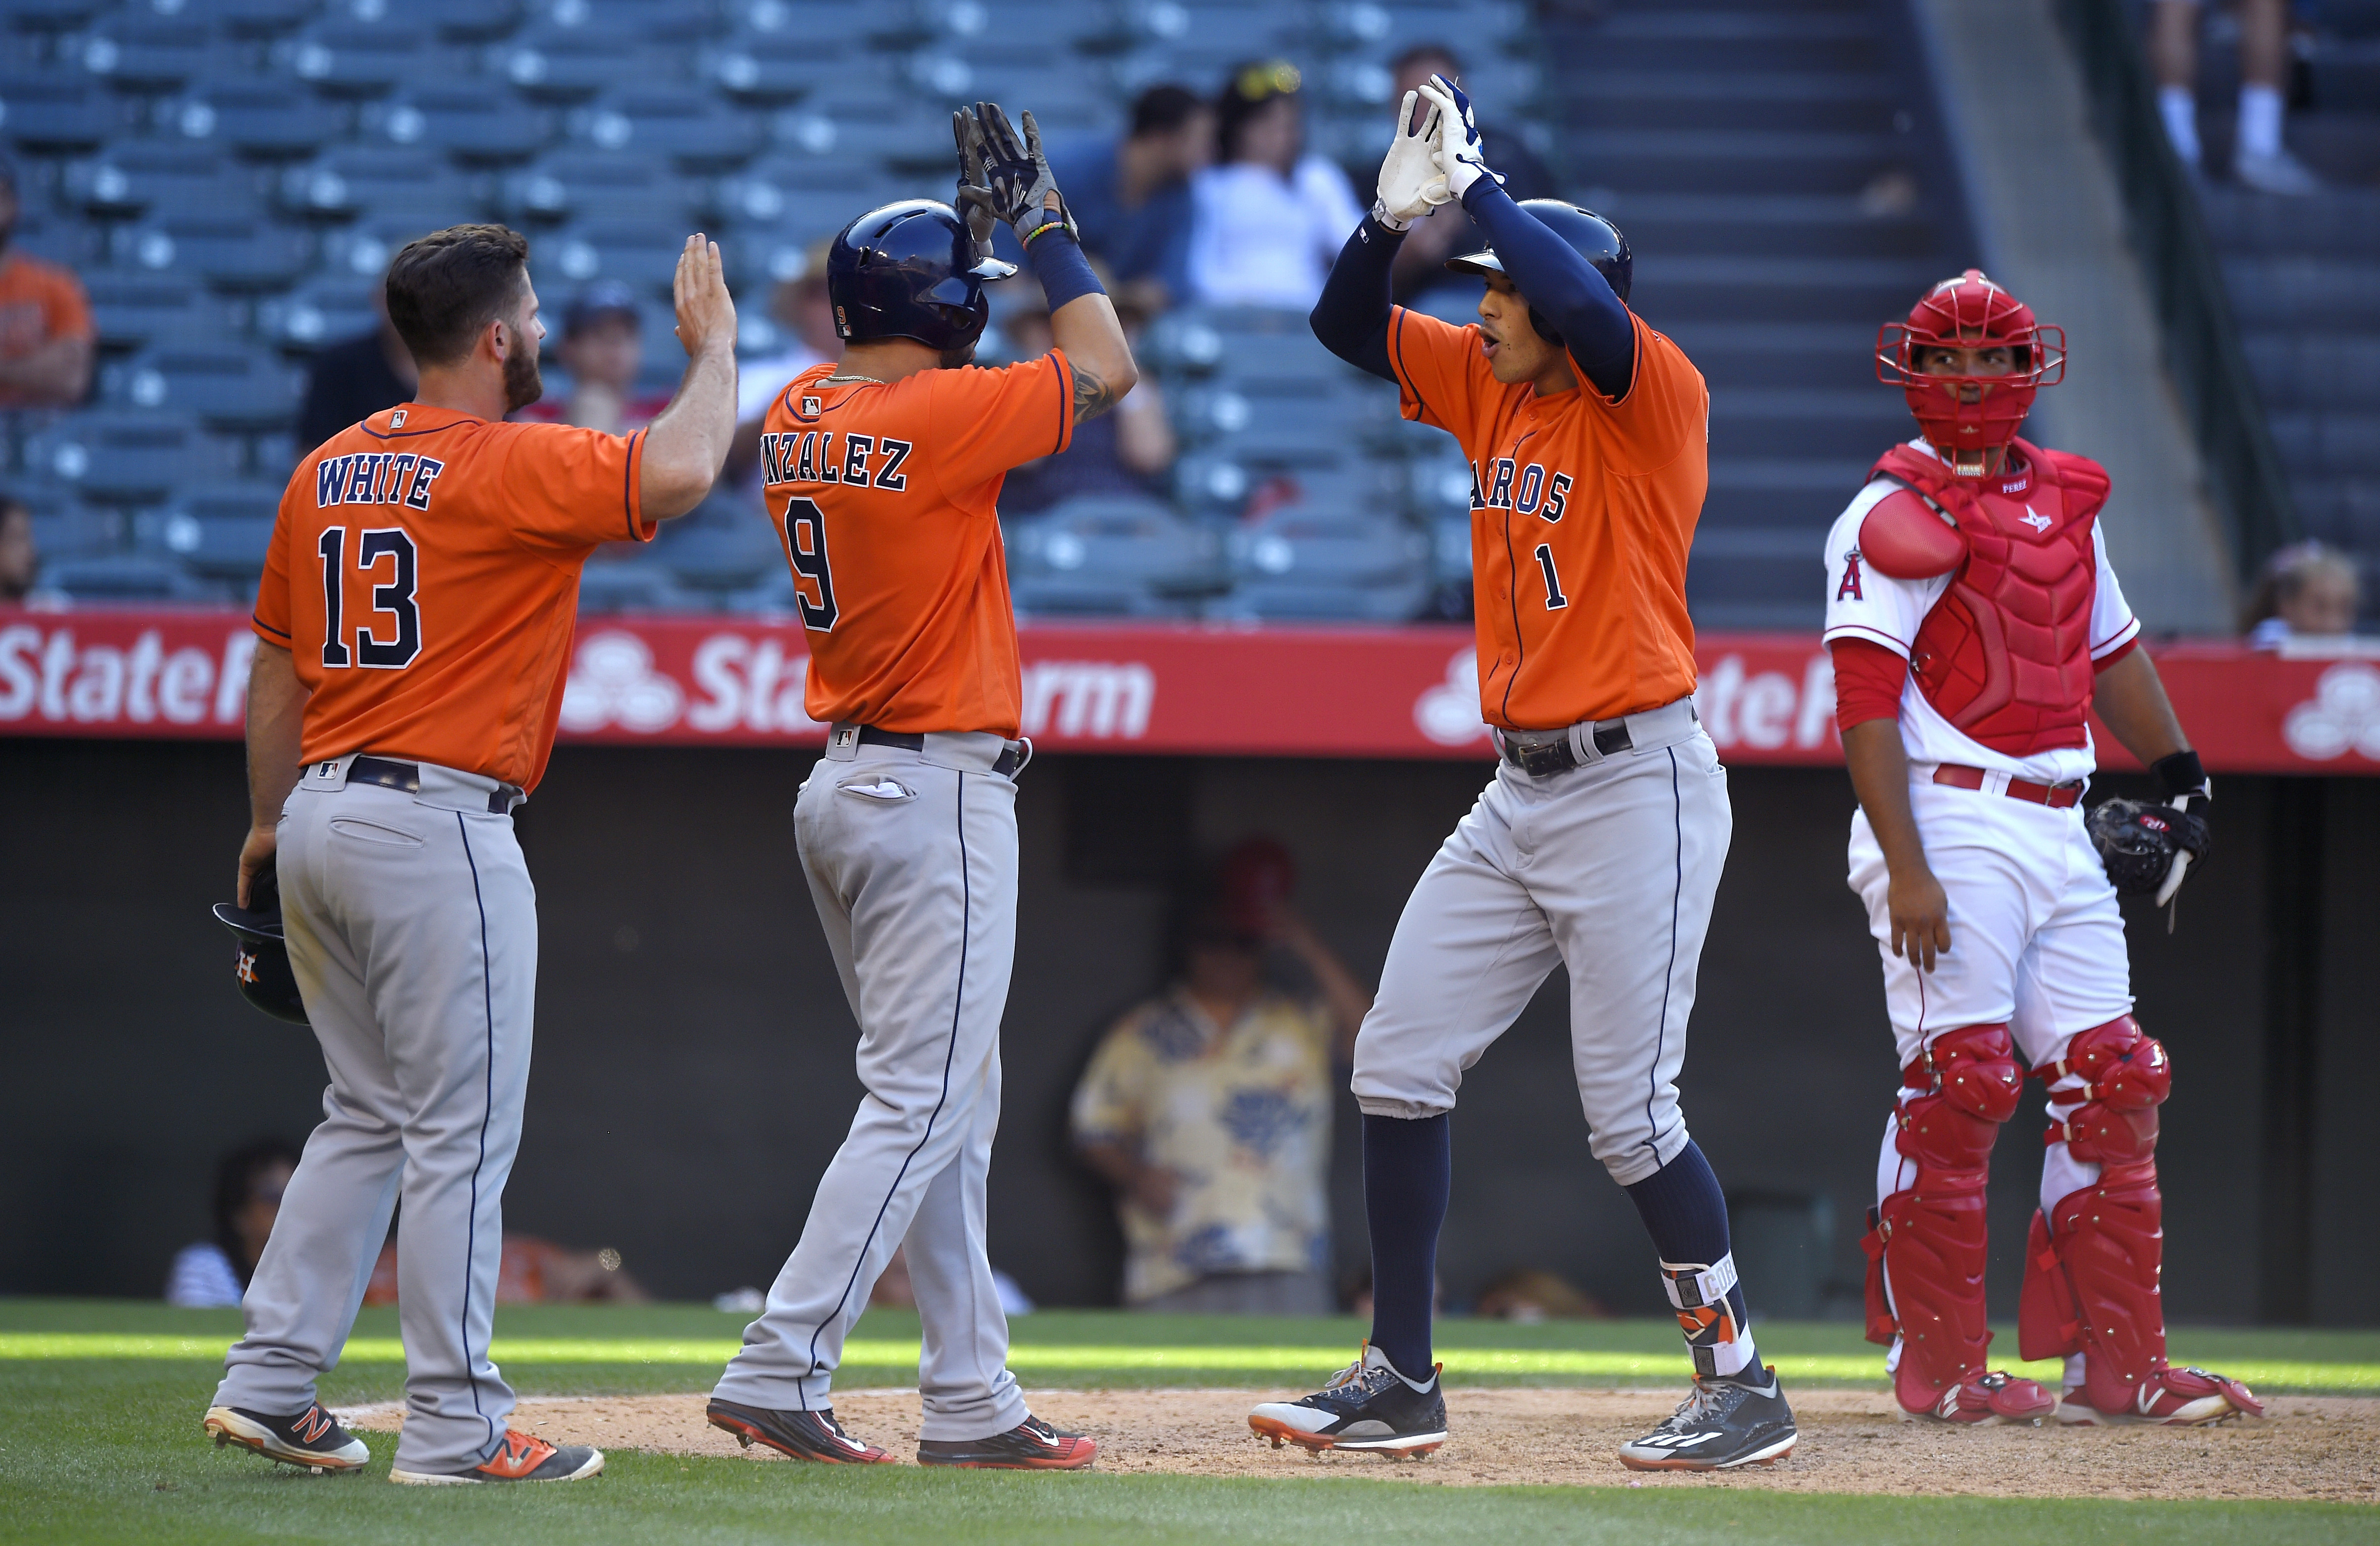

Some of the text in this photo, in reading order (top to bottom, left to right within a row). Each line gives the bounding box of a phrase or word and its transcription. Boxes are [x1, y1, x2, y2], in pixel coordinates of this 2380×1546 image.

[837, 306, 846, 324] 9
[317, 453, 445, 512] WHITE
[760, 431, 913, 492] NZALEZ
[1469, 457, 1574, 524] AROS
[2003, 479, 2026, 493] PEREZ
[784, 496, 839, 633] 9
[1534, 543, 1568, 611] 1
[317, 526, 422, 670] 13
